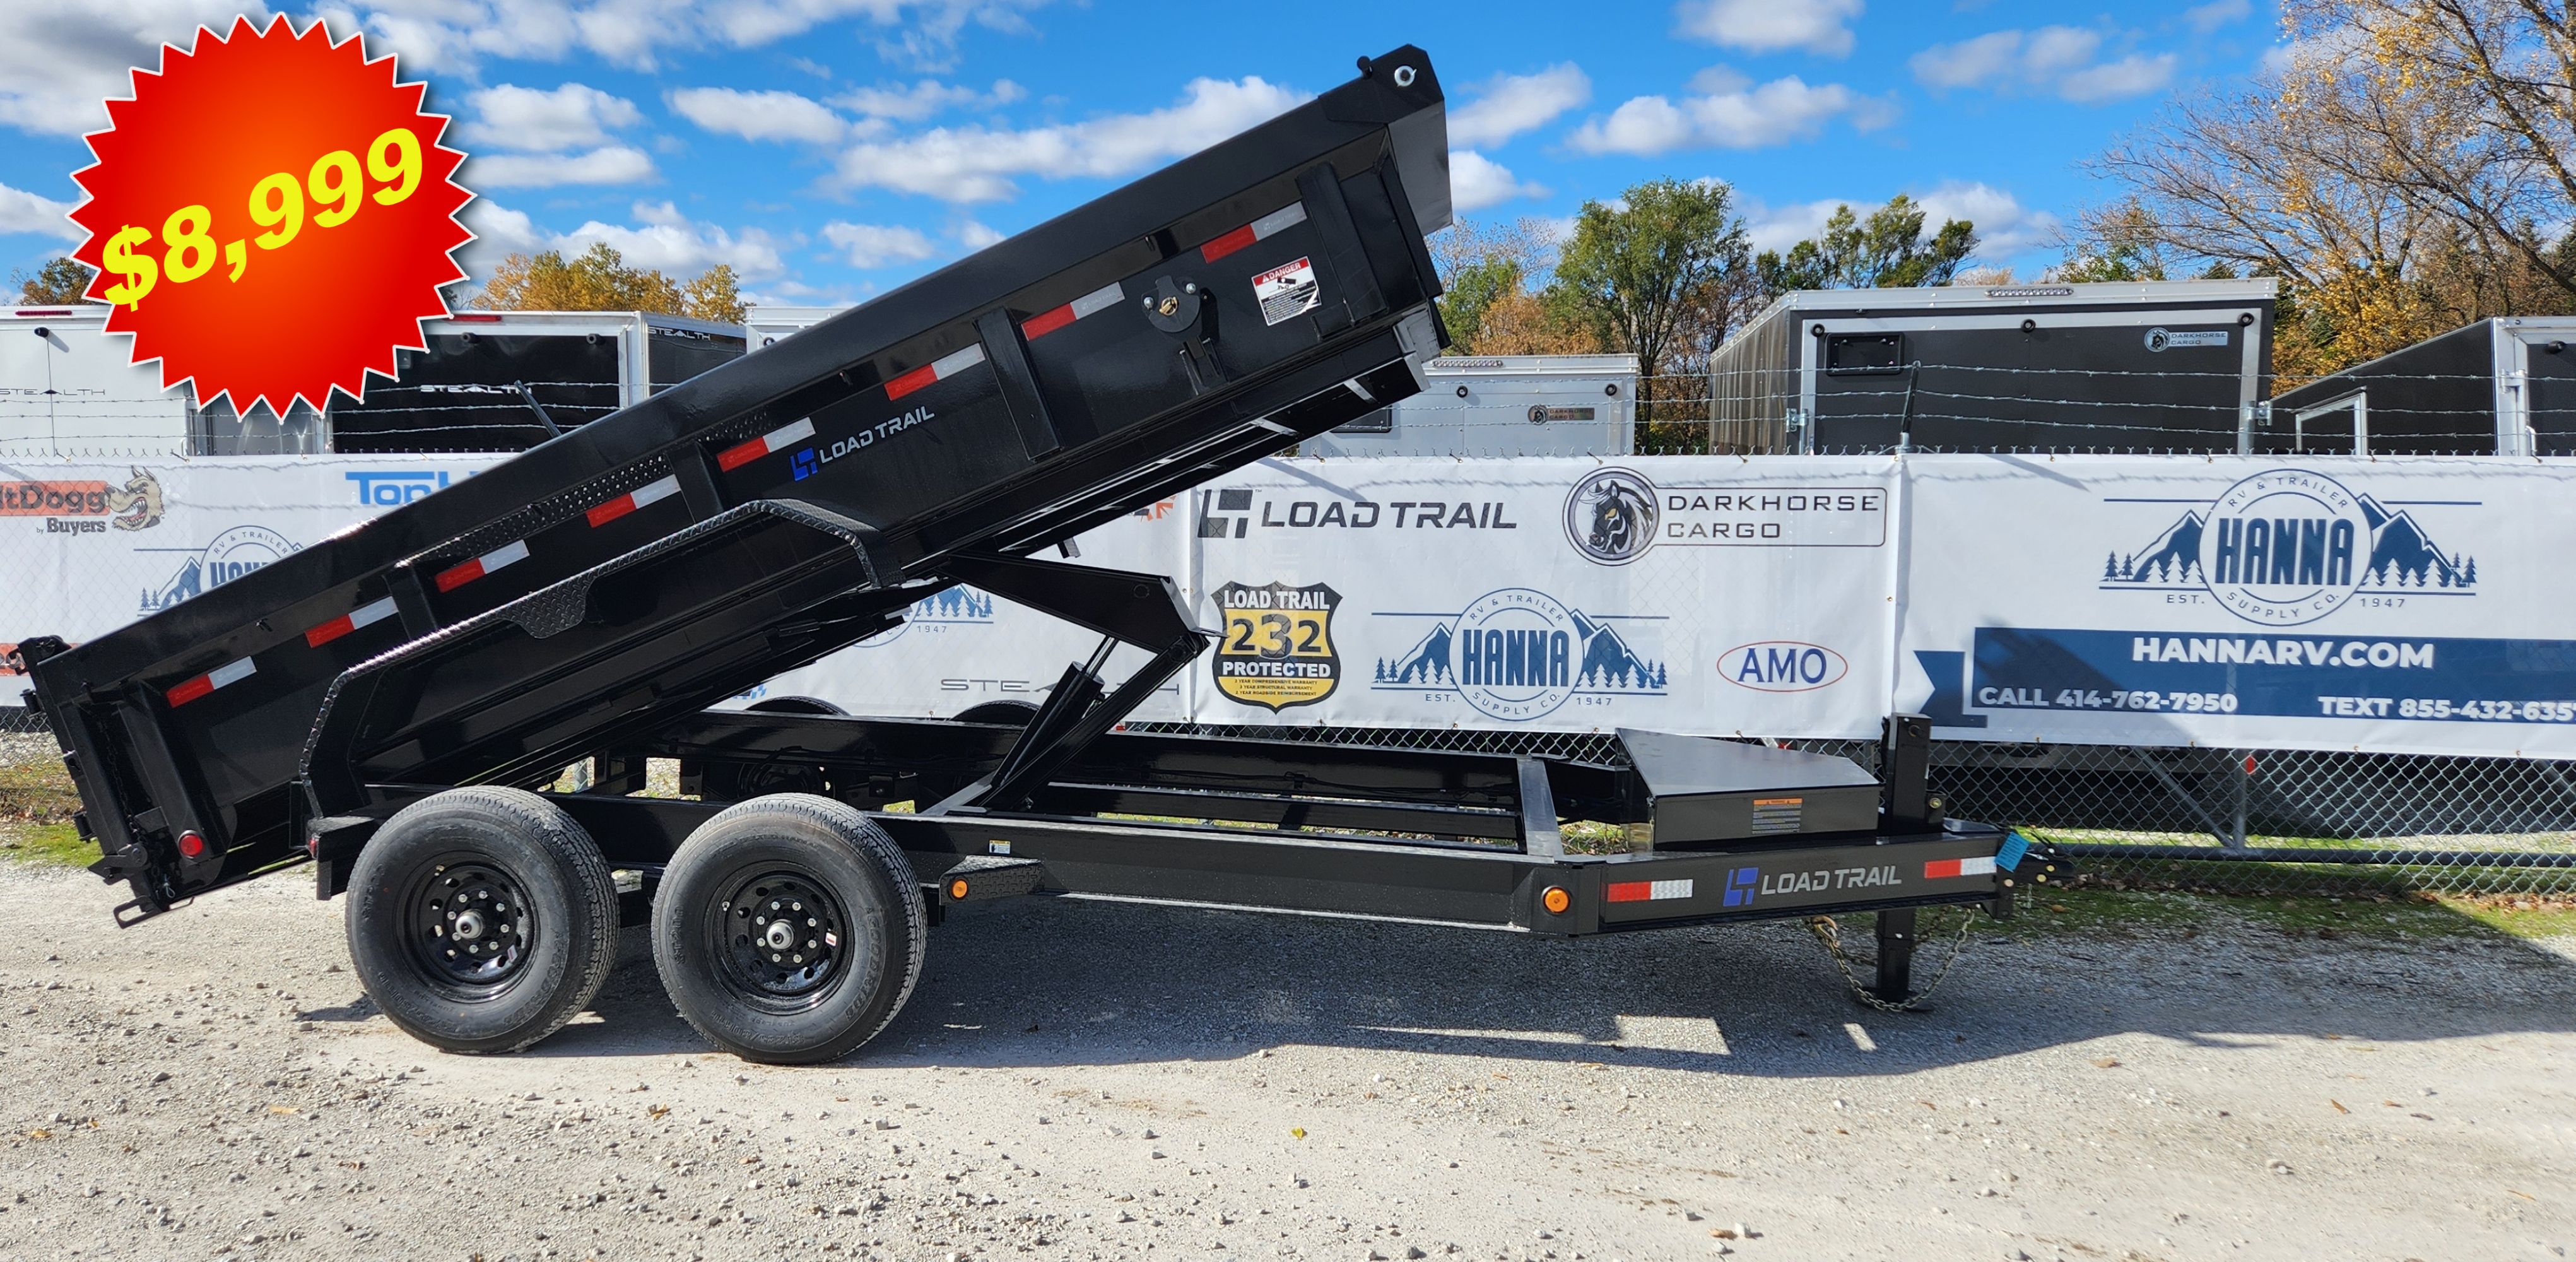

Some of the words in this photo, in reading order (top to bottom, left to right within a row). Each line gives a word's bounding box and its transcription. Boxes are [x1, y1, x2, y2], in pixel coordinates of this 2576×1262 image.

[1269, 262, 1301, 280] DANGER
[648, 326, 710, 341] STEALTH
[820, 429, 874, 464] LOAD
[875, 406, 935, 439] TRAIL
[1668, 495, 1879, 511] DARKHORSE
[2228, 492, 2247, 508] RV
[2257, 481, 2265, 490] &
[2276, 476, 2349, 509] TRAILER
[37, 527, 44, 535] by
[47, 517, 106, 536] Buyers
[1262, 502, 1380, 528] LOAD
[1390, 502, 1517, 529] TRAIL
[213, 541, 225, 554] RV
[242, 531, 288, 554] TRAILER
[1667, 522, 1780, 539] CARGO
[2214, 517, 2355, 586] HANNA
[1224, 590, 1271, 608] LOAD
[1276, 591, 1330, 610] TRAIL
[1469, 606, 1485, 621] RV
[1507, 594, 1565, 622] TRAILER
[2167, 593, 2204, 604] EST.
[2226, 591, 2300, 618] SUPPLY
[2314, 593, 2340, 610] CO.
[2360, 598, 2406, 608] 1947
[1231, 613, 1322, 659] 232
[1462, 629, 1570, 687] HANNA
[2132, 637, 2433, 669] HANNARV.COM
[1222, 661, 1331, 678] PROTECTED
[1737, 647, 1827, 684] AMO
[1425, 694, 1456, 702] EST.
[1472, 692, 1531, 715] SUPPLY
[1541, 693, 1561, 708] CO.
[1577, 697, 1613, 706] 1947
[1979, 687, 2050, 707] CALL
[2056, 688, 2238, 712] 414-762-7950
[2318, 695, 2393, 717] TEXT
[2399, 698, 2576, 721] 855-432-635
[1761, 870, 1830, 895] LOAD
[1835, 865, 1902, 890] TRAIL
